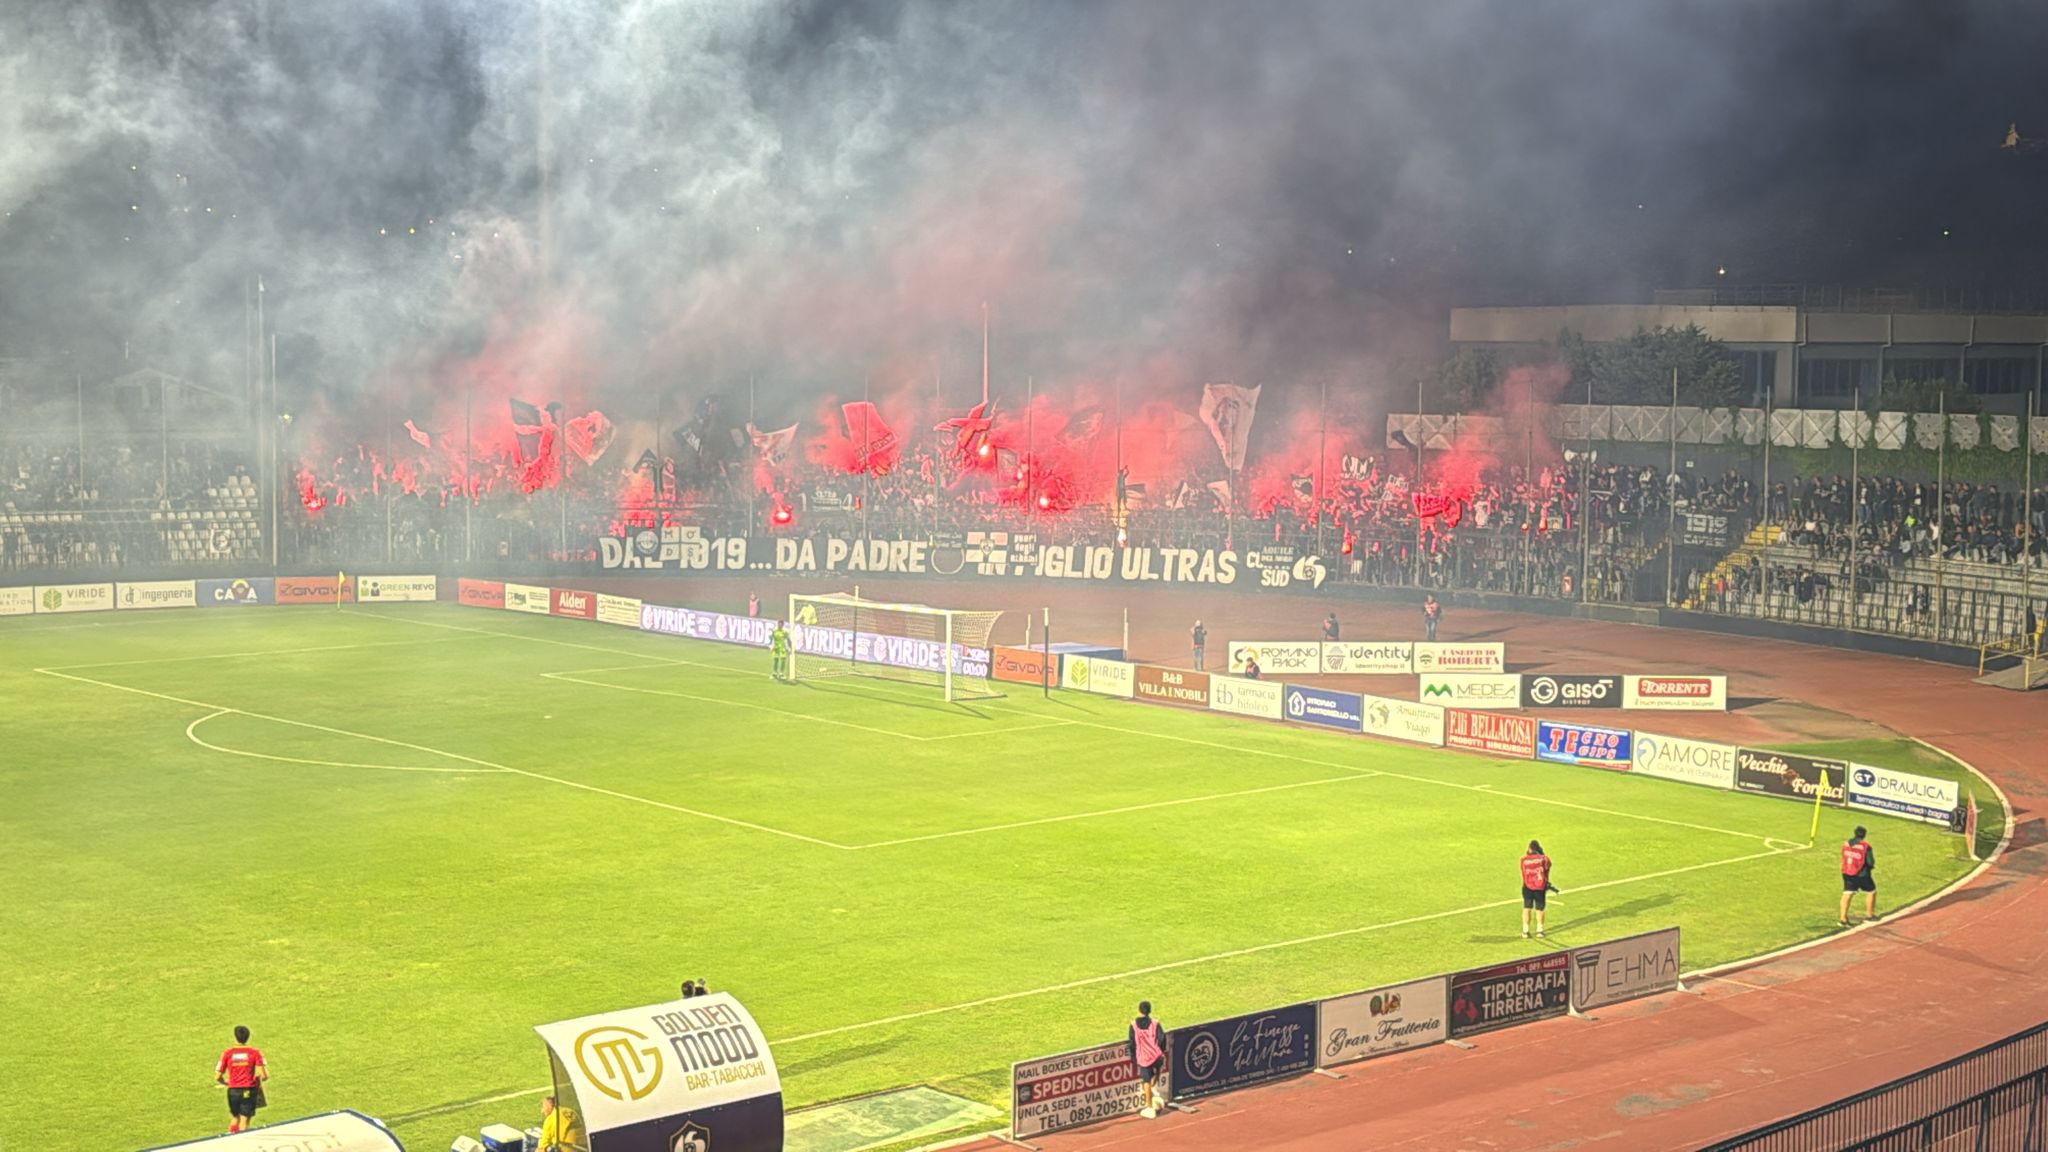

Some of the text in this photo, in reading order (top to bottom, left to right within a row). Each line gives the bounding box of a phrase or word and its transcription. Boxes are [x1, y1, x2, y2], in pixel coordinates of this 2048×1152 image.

[776, 538, 816, 571] DA
[826, 540, 927, 573] PADRE
[1014, 545, 1112, 579] IGLIO
[1122, 547, 1237, 584] ULTRAS
[412, 583, 435, 591] REVO
[1261, 569, 1290, 587] SUD
[142, 589, 192, 603] ingegneria
[559, 591, 586, 609] Alden
[652, 608, 696, 633] VIRIDE
[727, 617, 774, 645] VIRIDE
[803, 627, 853, 656] VIRIDE
[888, 638, 940, 667] VIRIDE
[1261, 648, 1318, 657] ROMANO
[1350, 646, 1411, 661] identity
[1272, 658, 1306, 668] PACK
[1438, 657, 1500, 665] ROBERTA
[1162, 672, 1183, 684] B&B
[1457, 684, 1516, 695] MEDEA
[1642, 680, 1709, 694] TORRENTE
[1139, 682, 1169, 697] VILLA
[1174, 690, 1207, 702] NOBILI
[1470, 712, 1531, 745] BELLACOSA
[1550, 728, 1619, 753] TECNO
[1578, 745, 1617, 759] GIPS
[1658, 742, 1732, 771] AMORE
[1739, 754, 1788, 774] Vecchie
[1791, 778, 1845, 798] Foraci
[1877, 777, 1945, 800] IDRAULICA
[1482, 970, 1566, 1002] TIPOGRAFIA
[1482, 992, 1543, 1019] TIRRENA
[651, 1003, 741, 1036] GOLDEN
[670, 1024, 759, 1072] MOOD
[1326, 1027, 1371, 1057] Gran
[1374, 1017, 1441, 1041] Frutteria
[686, 1060, 766, 1091] BAR-TABACCHI
[1017, 1069, 1040, 1080] MAIL
[1042, 1061, 1071, 1074] BOXES
[1073, 1056, 1091, 1067] ETC.
[1093, 1051, 1116, 1064] CAVA
[1033, 1063, 1133, 1100] SPEDISCI CON
[1018, 1104, 1049, 1119] UNICA
[1052, 1098, 1077, 1112] SEDE
[1084, 1093, 1102, 1105] VIA
[1115, 1082, 1140, 1096] VENE
[1040, 1114, 1067, 1130] TEL.
